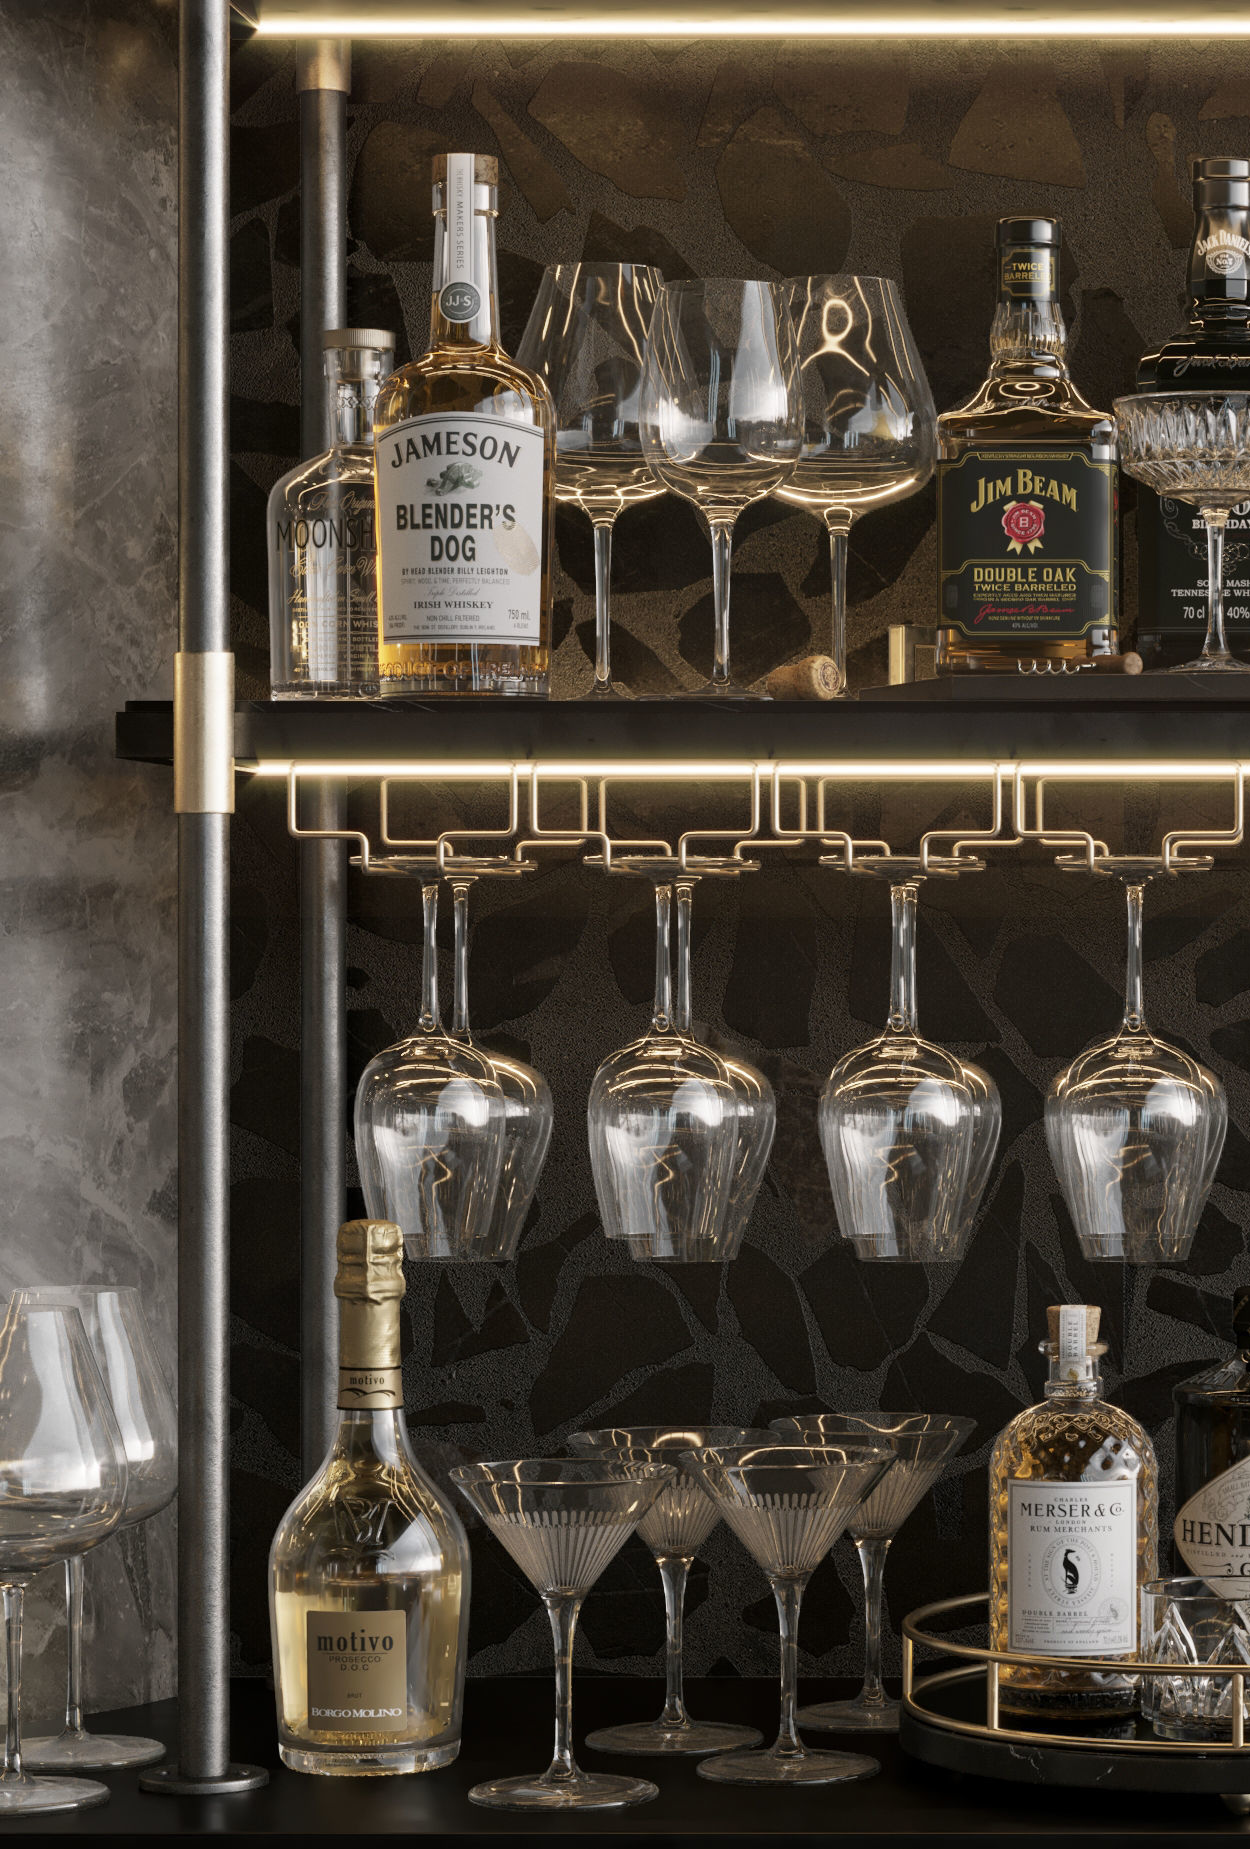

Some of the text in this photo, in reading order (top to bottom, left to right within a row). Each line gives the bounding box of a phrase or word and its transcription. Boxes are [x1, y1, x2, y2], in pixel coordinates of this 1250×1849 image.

[457, 201, 465, 236] MAKERS
[1012, 263, 1045, 271] TWICE
[392, 431, 522, 468] JAMESON
[971, 468, 1079, 513] JIM BEAM
[396, 503, 517, 531] BLENDER'S
[430, 534, 476, 562] DOG
[411, 568, 426, 576] HEAD
[428, 567, 455, 576] BLENDER
[457, 567, 475, 575] BILLY
[477, 567, 509, 576] LEIGHTON
[974, 567, 1077, 583] DOUBLE OAK
[973, 584, 1077, 592] TWICE BARRELED
[413, 600, 494, 609] IRISH WHISKEY
[507, 609, 521, 621] 750
[1183, 605, 1195, 619] 70
[1196, 604, 1206, 619] cl
[1226, 605, 1250, 619] 40%
[349, 1373, 386, 1385] motivo
[1020, 1503, 1091, 1518] MERSER
[1093, 1503, 1106, 1518] &
[1029, 1525, 1113, 1533] RUM MERCHANTS
[1022, 1609, 1089, 1617] DOUBLE BARREL
[317, 1629, 394, 1652] motivo
[328, 1654, 381, 1664] PROSECCO
[311, 1706, 403, 1718] BORGO MOLINO
